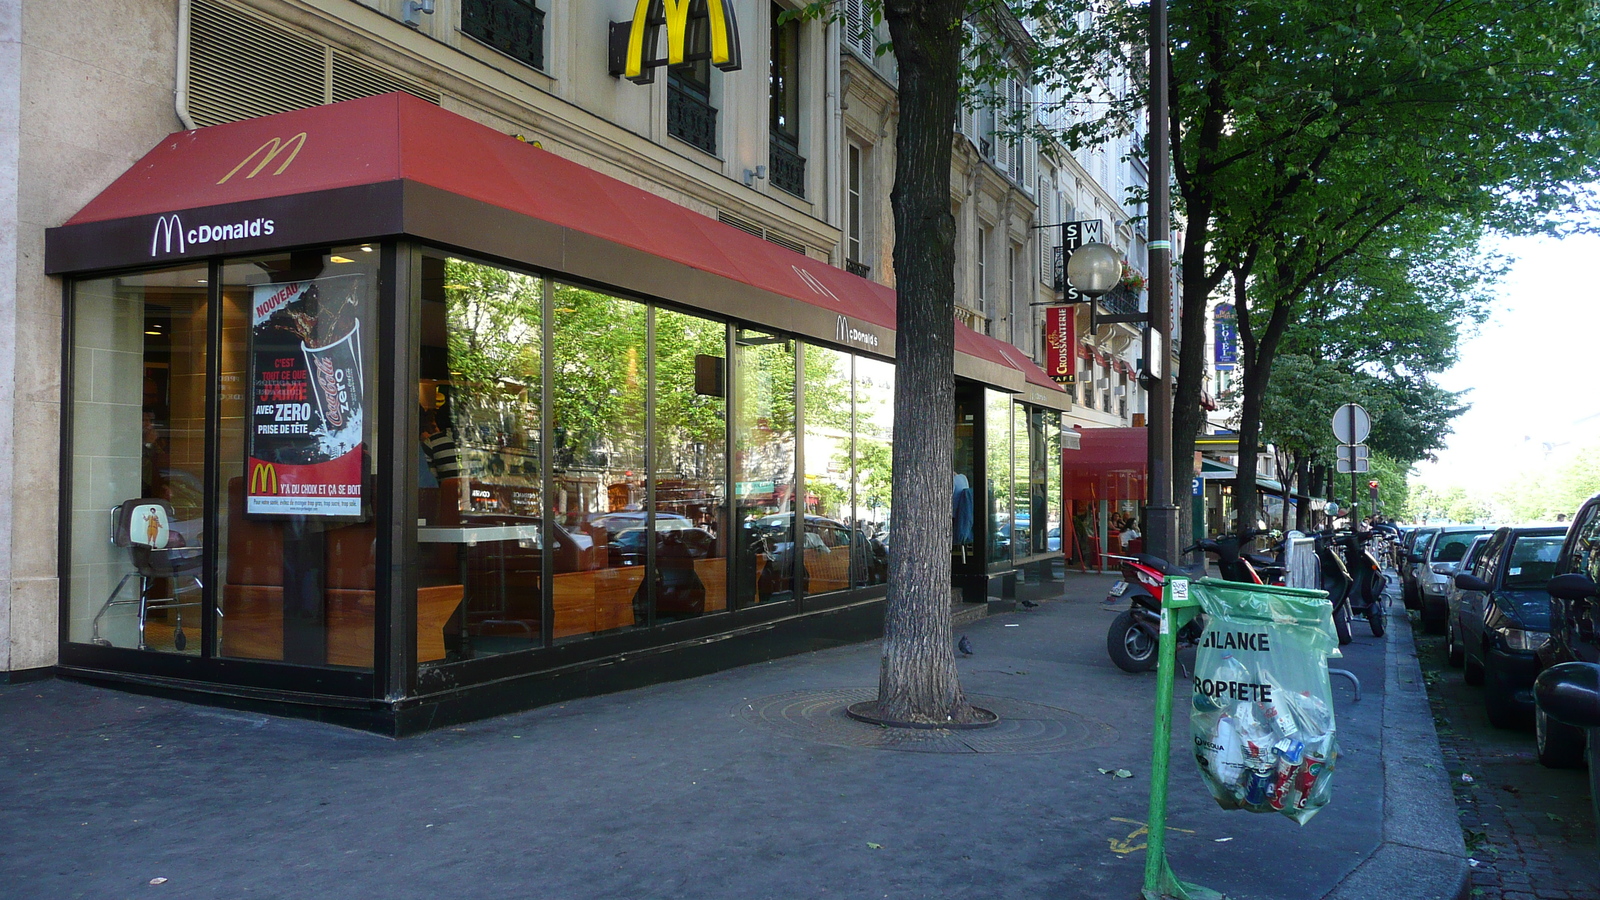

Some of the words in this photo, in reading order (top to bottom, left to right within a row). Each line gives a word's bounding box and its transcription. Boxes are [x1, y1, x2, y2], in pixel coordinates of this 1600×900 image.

[151, 213, 275, 257] McDonald's
[255, 283, 299, 318] NOUVEAU
[1056, 308, 1068, 374] CROISSANTERIE
[262, 371, 280, 381] TOUT
[281, 370, 291, 380] CE
[292, 369, 307, 380] QUE
[274, 358, 295, 368] C'EST
[335, 368, 349, 414] zero
[255, 404, 274, 415] AVEC
[275, 402, 311, 422] ZERO
[258, 424, 279, 435] PRISE
[280, 424, 290, 434] DE
[290, 421, 308, 434] TÊTE
[280, 484, 290, 494] Y'A
[291, 484, 300, 494] DU
[301, 484, 317, 494] CHOIX
[318, 484, 327, 494] ET
[328, 484, 338, 496] ÇA
[338, 484, 346, 494] SE
[347, 484, 362, 495] BOIT
[1193, 675, 1273, 703] ROPRETE
